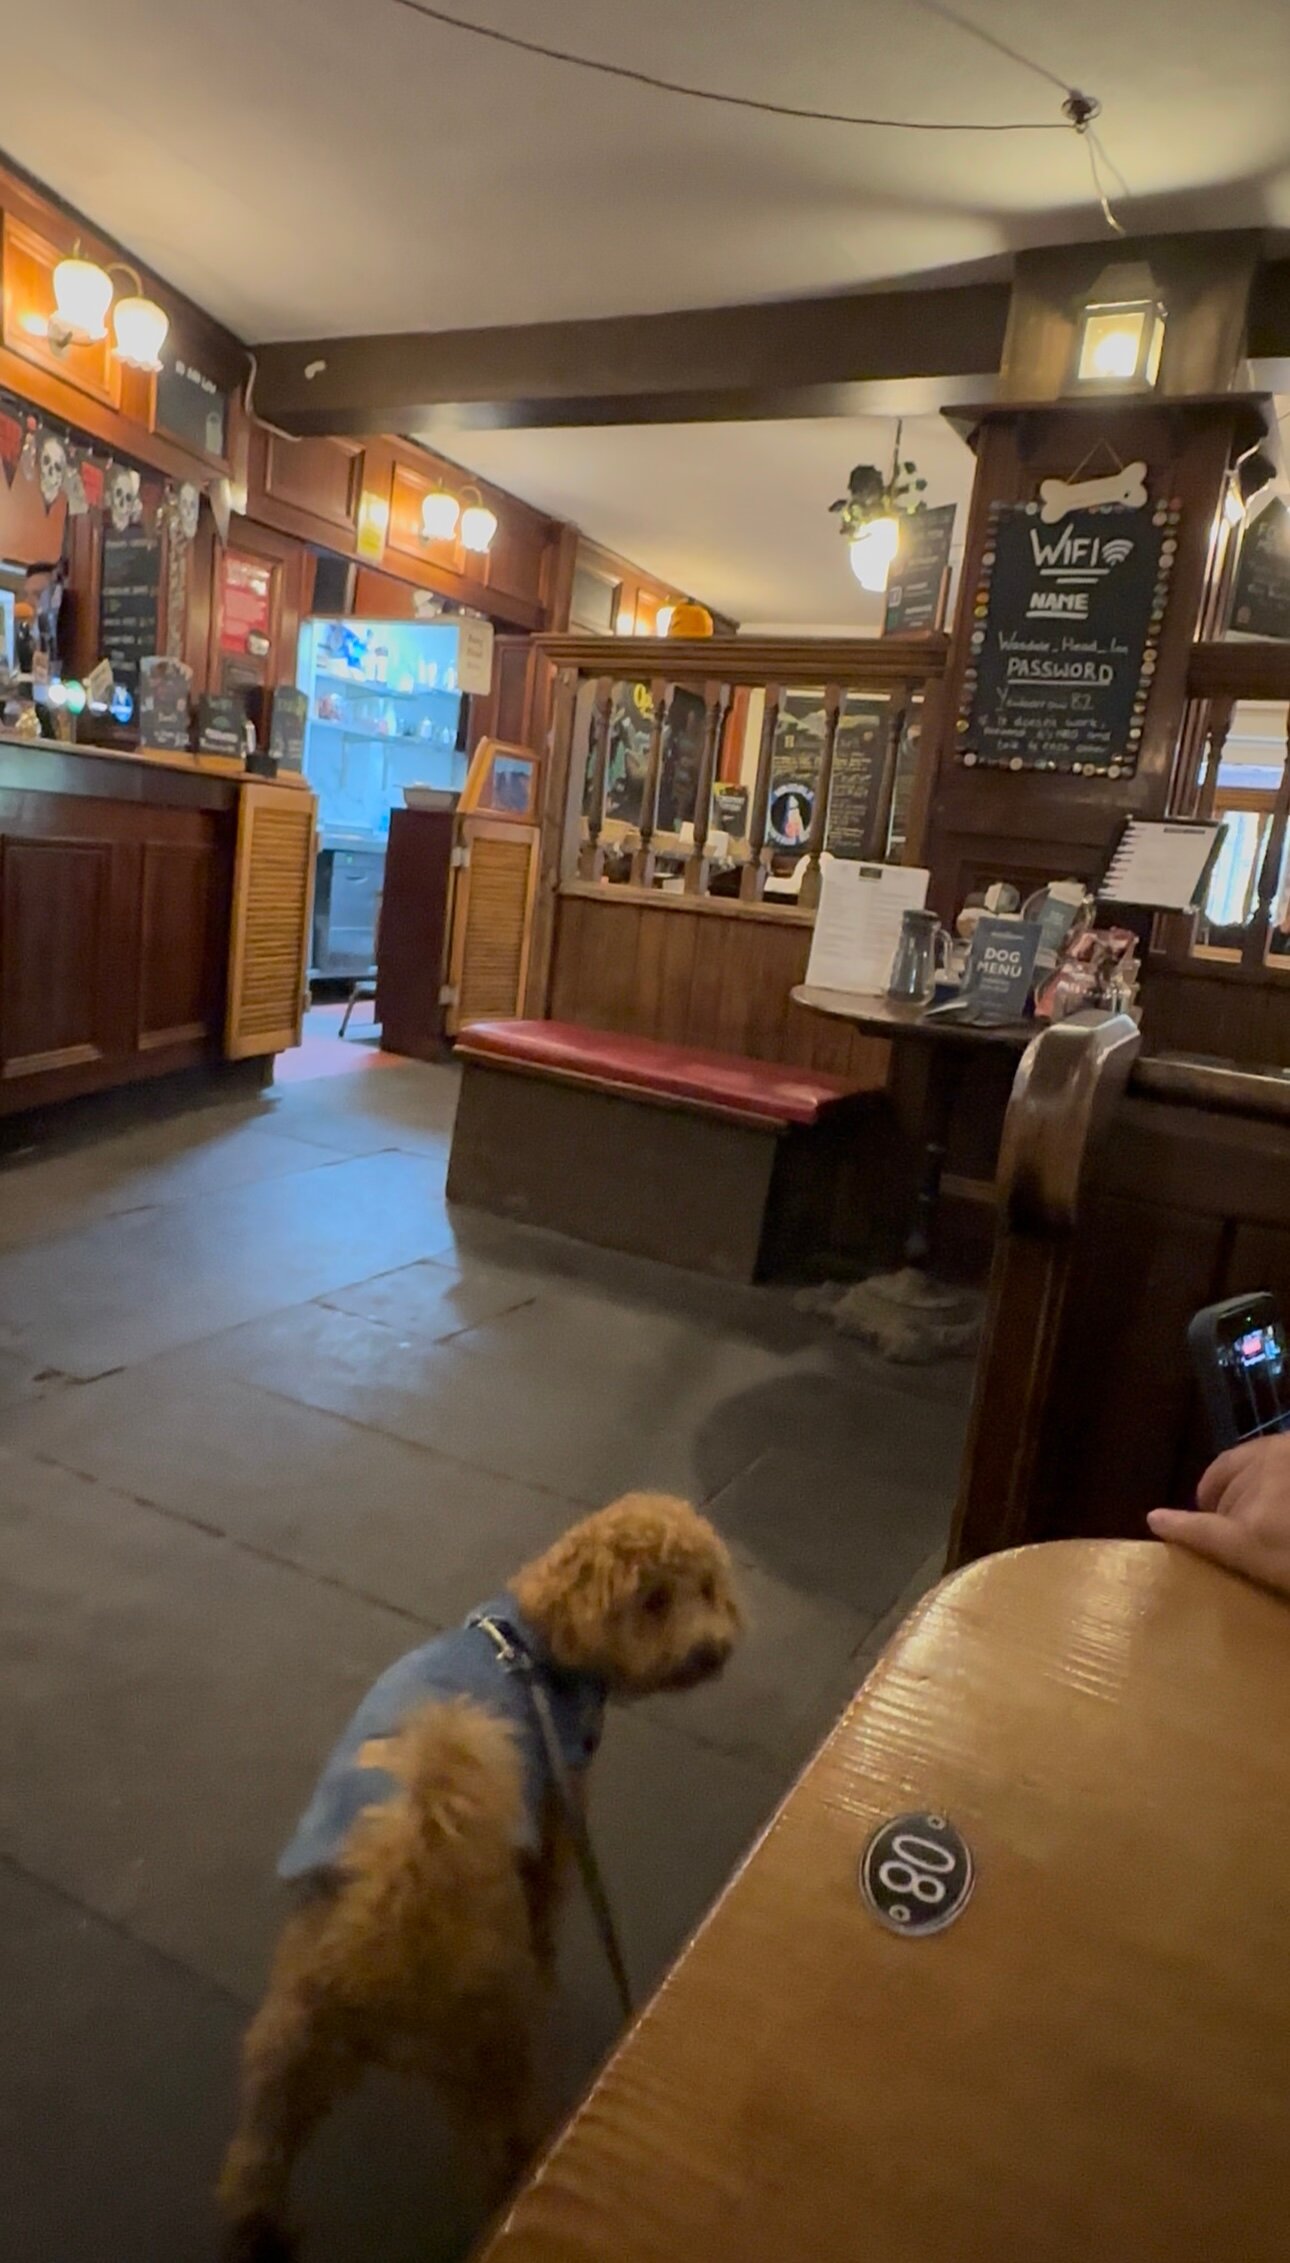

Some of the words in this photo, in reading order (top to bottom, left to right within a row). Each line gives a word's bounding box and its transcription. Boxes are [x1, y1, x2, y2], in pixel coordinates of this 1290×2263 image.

[1030, 522, 1100, 567] WIFI
[1029, 591, 1090, 612] NAME
[1006, 657, 1114, 682] PASSWORD
[984, 946, 1021, 964] DOG
[976, 960, 1023, 979] MENU
[878, 1833, 956, 1904] 80
